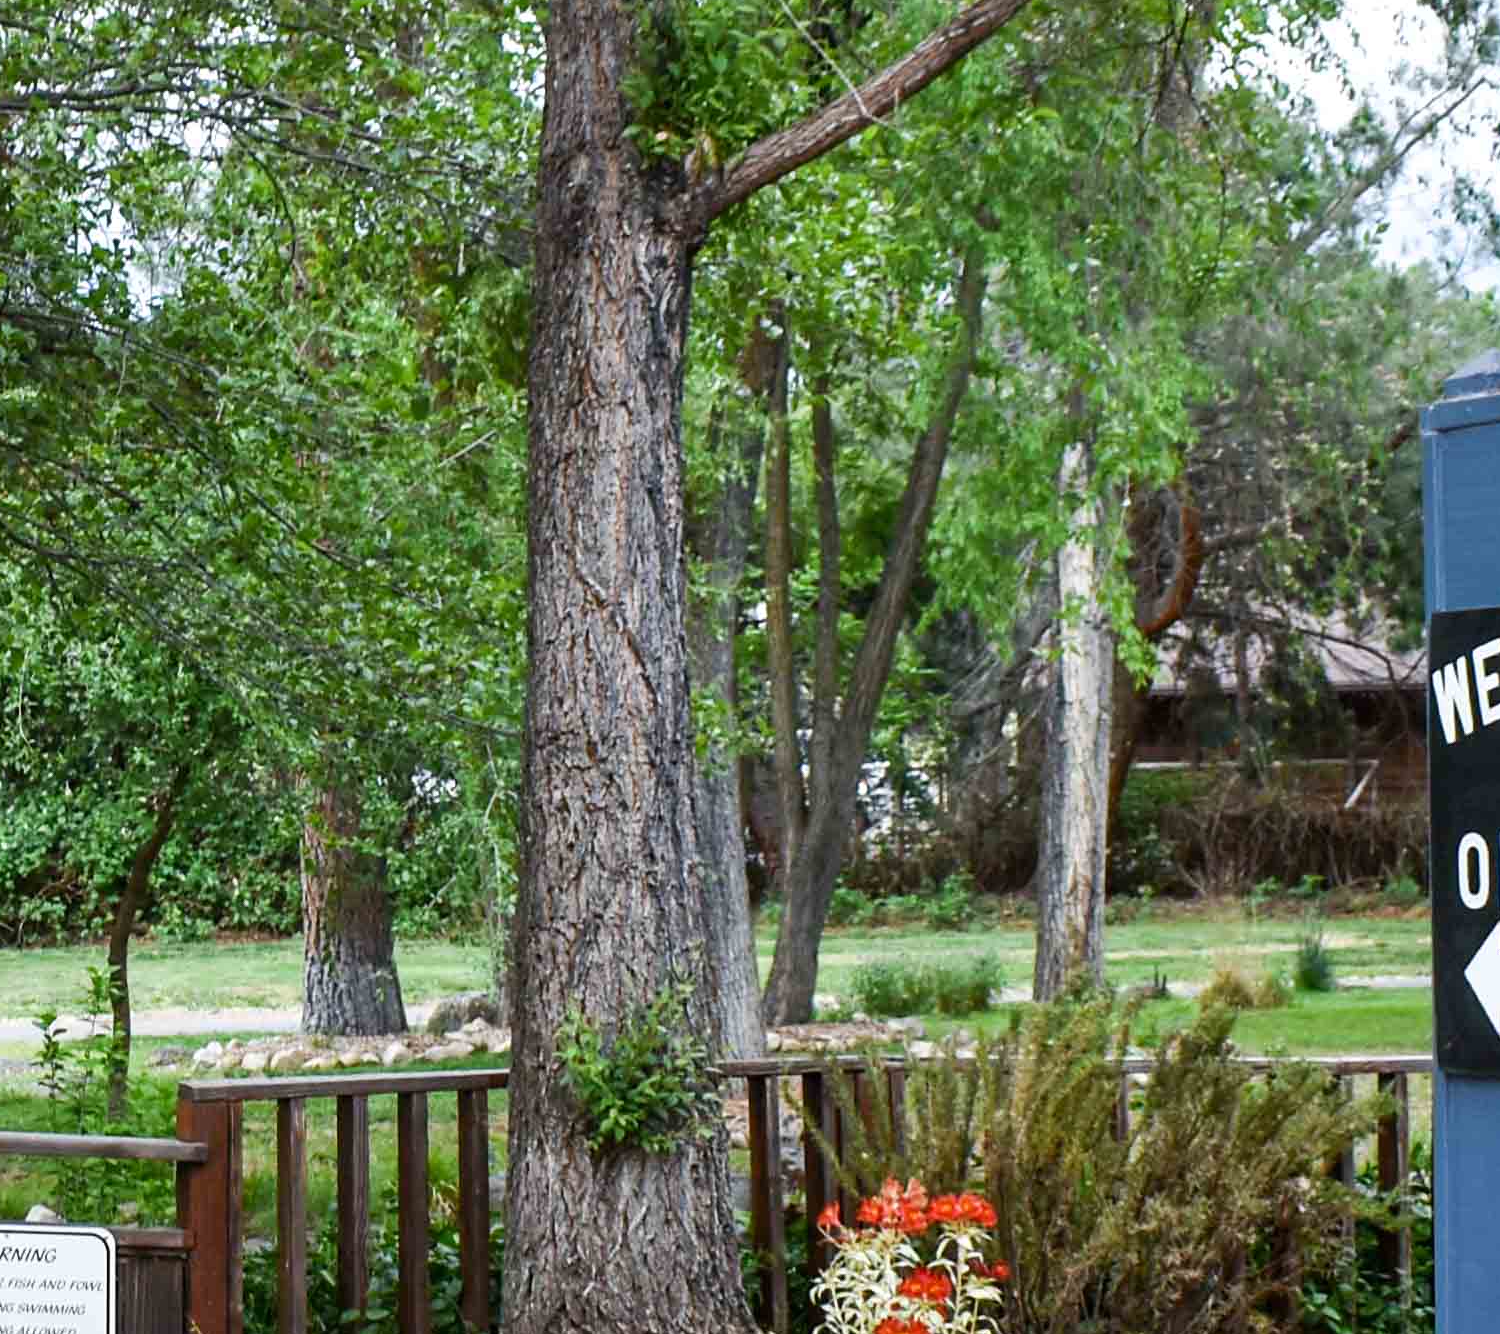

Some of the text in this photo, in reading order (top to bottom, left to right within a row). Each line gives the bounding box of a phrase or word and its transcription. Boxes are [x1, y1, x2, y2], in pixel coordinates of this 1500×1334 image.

[8, 1278, 36, 1290] FISH
[39, 1279, 67, 1291] AND
[69, 1280, 104, 1292] FOWL
[17, 1302, 87, 1316] SWIMMING
